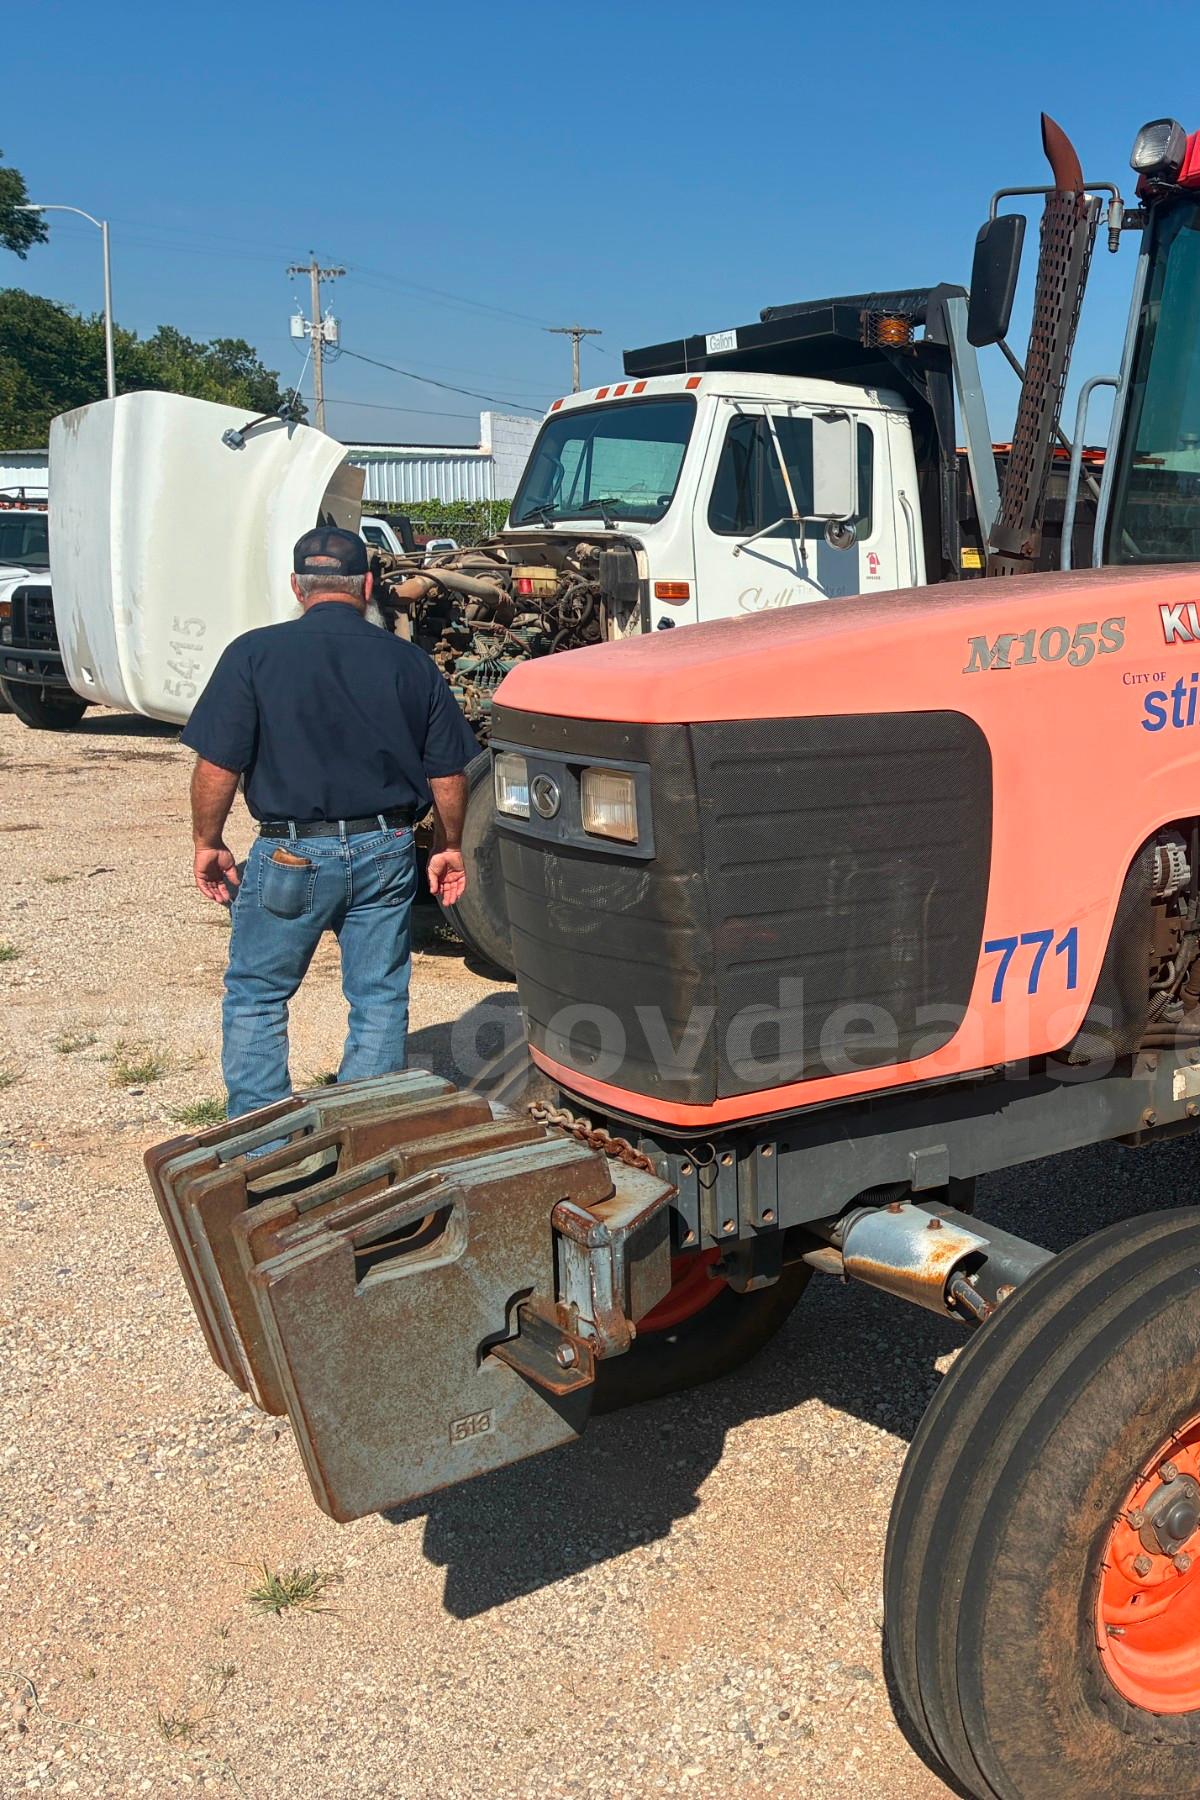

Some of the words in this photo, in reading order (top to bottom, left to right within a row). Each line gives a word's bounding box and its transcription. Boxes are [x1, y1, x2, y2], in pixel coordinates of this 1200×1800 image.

[162, 615, 207, 699] 5415
[962, 616, 1126, 674] M105S
[984, 927, 1078, 1004] 771
